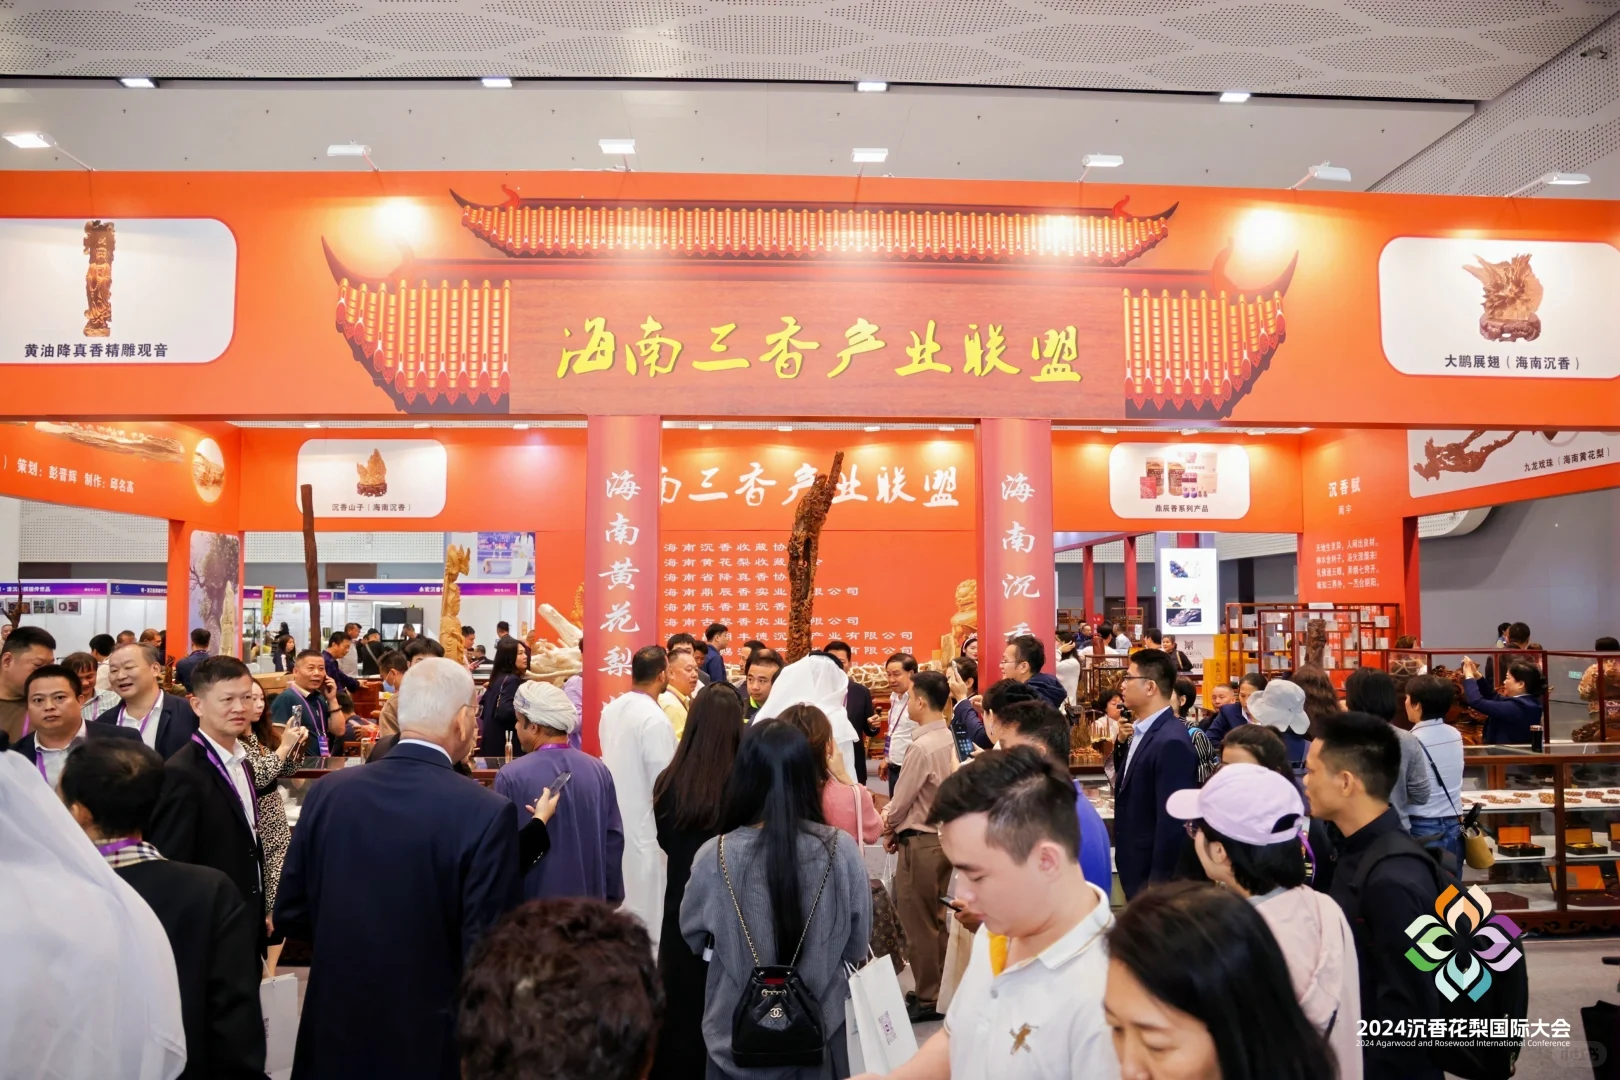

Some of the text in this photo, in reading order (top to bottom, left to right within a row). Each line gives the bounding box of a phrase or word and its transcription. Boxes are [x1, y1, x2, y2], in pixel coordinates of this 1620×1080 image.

[24, 343, 168, 358] 黄油降真香精雕观音
[557, 315, 1082, 383] 海南三香产业联盟
[1328, 476, 1361, 498] 沉香赋
[1155, 504, 1209, 513] 鼎辰香系列产品
[664, 558, 823, 567] 海南黄花梨收藏
[598, 469, 642, 712] 海南黄花梨
[664, 587, 858, 597] 海南鼎辰香实业限公司
